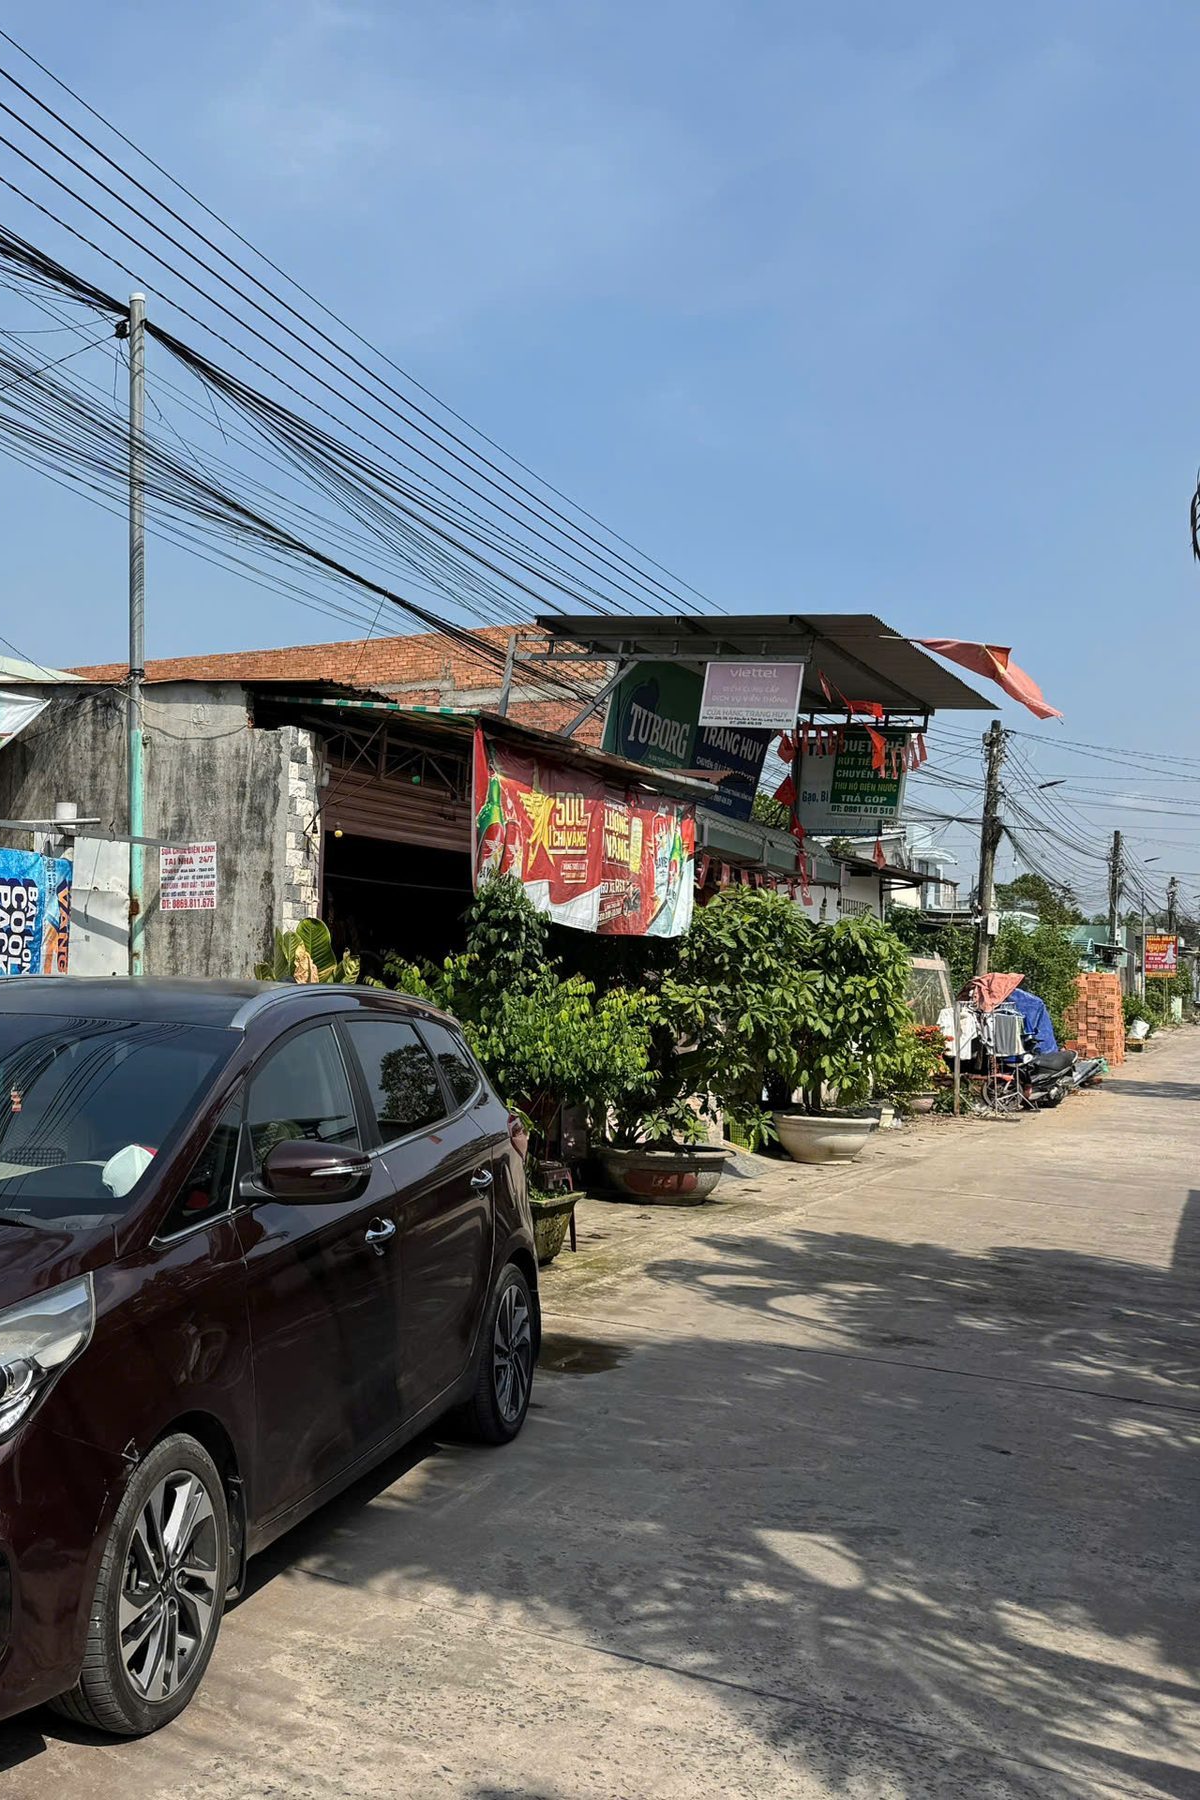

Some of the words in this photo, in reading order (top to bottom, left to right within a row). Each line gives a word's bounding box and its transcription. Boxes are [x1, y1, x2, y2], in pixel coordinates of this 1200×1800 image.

[730, 668, 777, 678] viettel
[627, 702, 690, 759] TUBORG
[702, 727, 740, 756] TRANG
[739, 737, 764, 763] HUY
[555, 792, 584, 826] 500
[841, 792, 861, 803] TRẢ
[864, 794, 887, 804] GÓP
[24, 886, 39, 930] BẬT
[7, 886, 27, 975] COOL
[22, 937, 33, 975] LON
